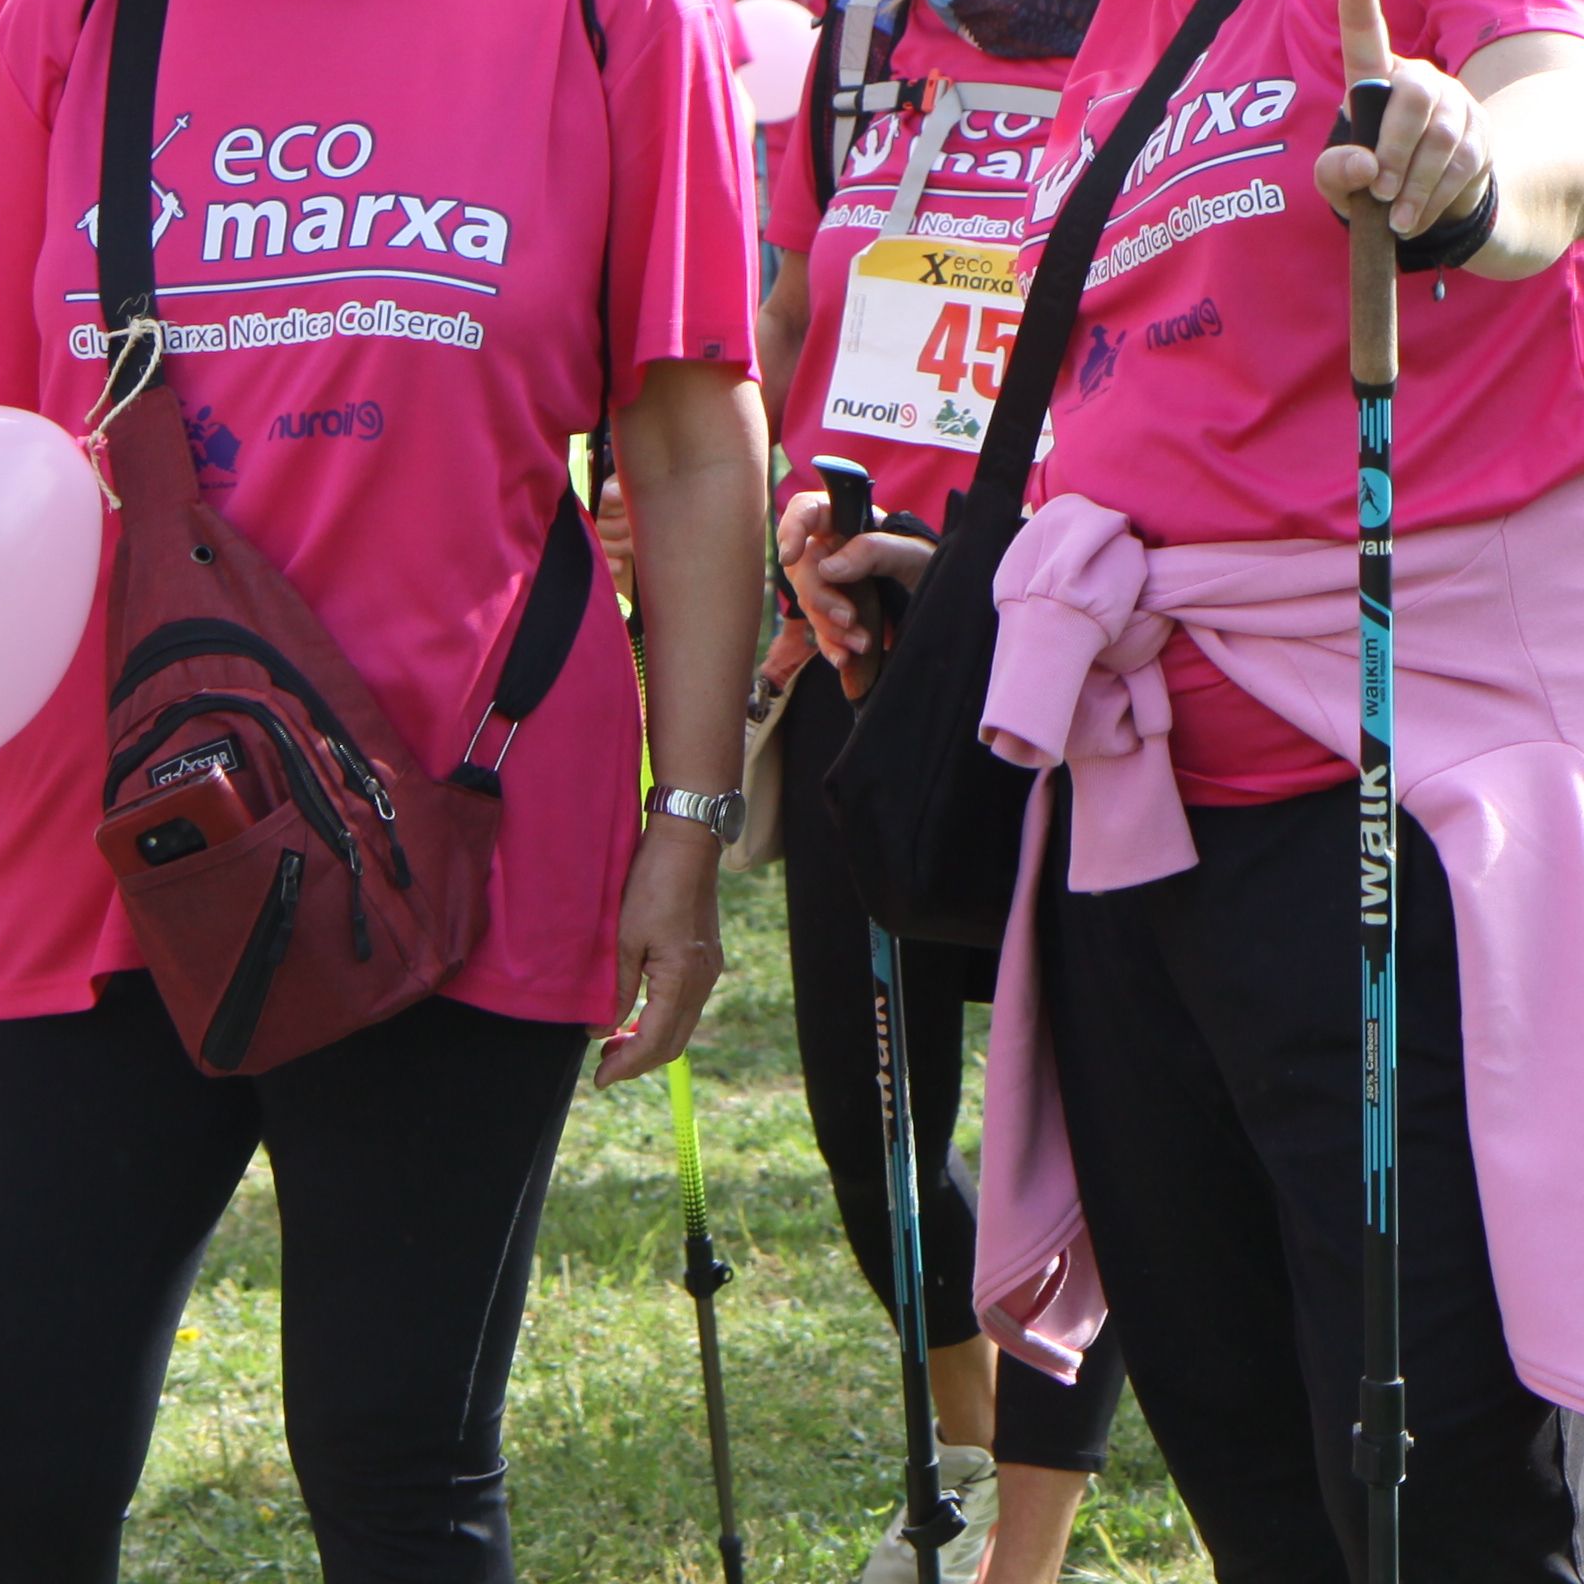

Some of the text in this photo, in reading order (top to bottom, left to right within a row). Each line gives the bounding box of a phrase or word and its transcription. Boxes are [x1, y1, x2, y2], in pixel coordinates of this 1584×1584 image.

[213, 121, 374, 185] eco
[202, 193, 510, 266] marxa
[918, 211, 1009, 238] Nòrdica
[1111, 222, 1172, 278] Nòrdica
[1168, 178, 1286, 244] Collserola
[950, 272, 1013, 294] marxa
[953, 255, 993, 274] eco
[69, 324, 109, 360] Clu
[229, 308, 334, 349] Nòrdica
[335, 300, 485, 351] Collserola
[1366, 1021, 1375, 1071] Carbono
